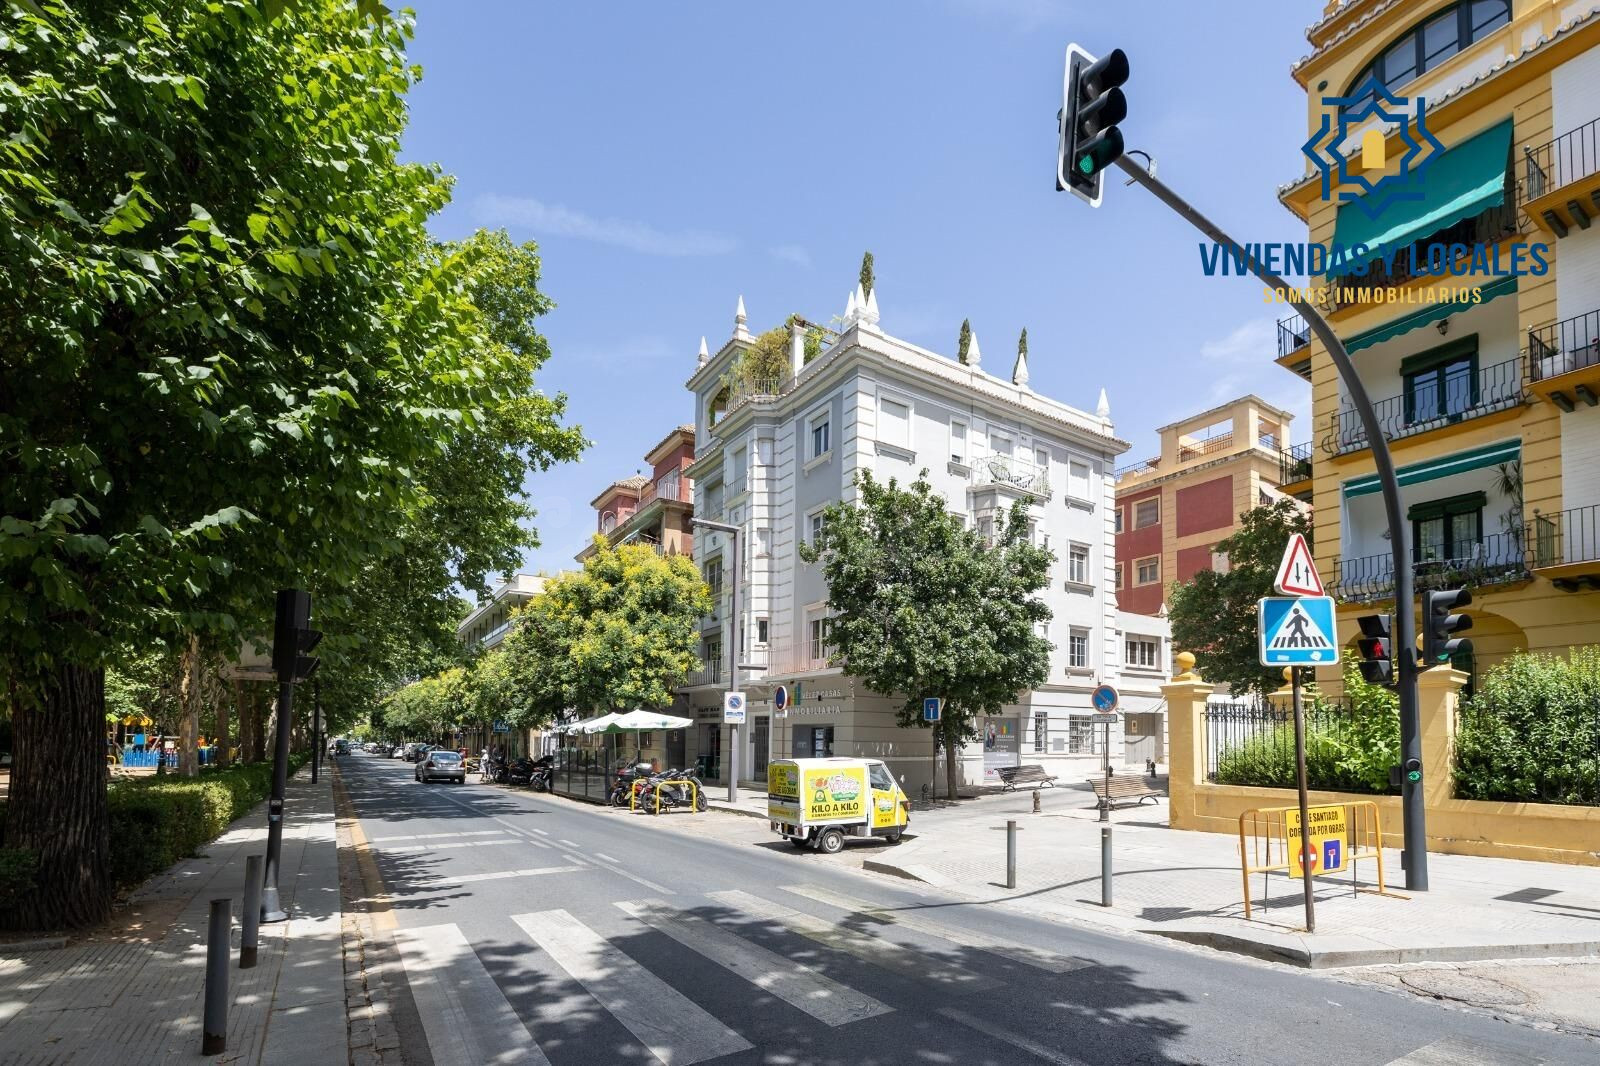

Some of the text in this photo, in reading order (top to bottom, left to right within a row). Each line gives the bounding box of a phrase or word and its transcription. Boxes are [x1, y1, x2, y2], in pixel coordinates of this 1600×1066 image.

[789, 705, 841, 716] NMOBILIARIA
[812, 802, 858, 813] KILO A KILO
[1312, 810, 1338, 822] SANTIAGO
[1289, 824, 1345, 837] CORDA POR OBRAS
